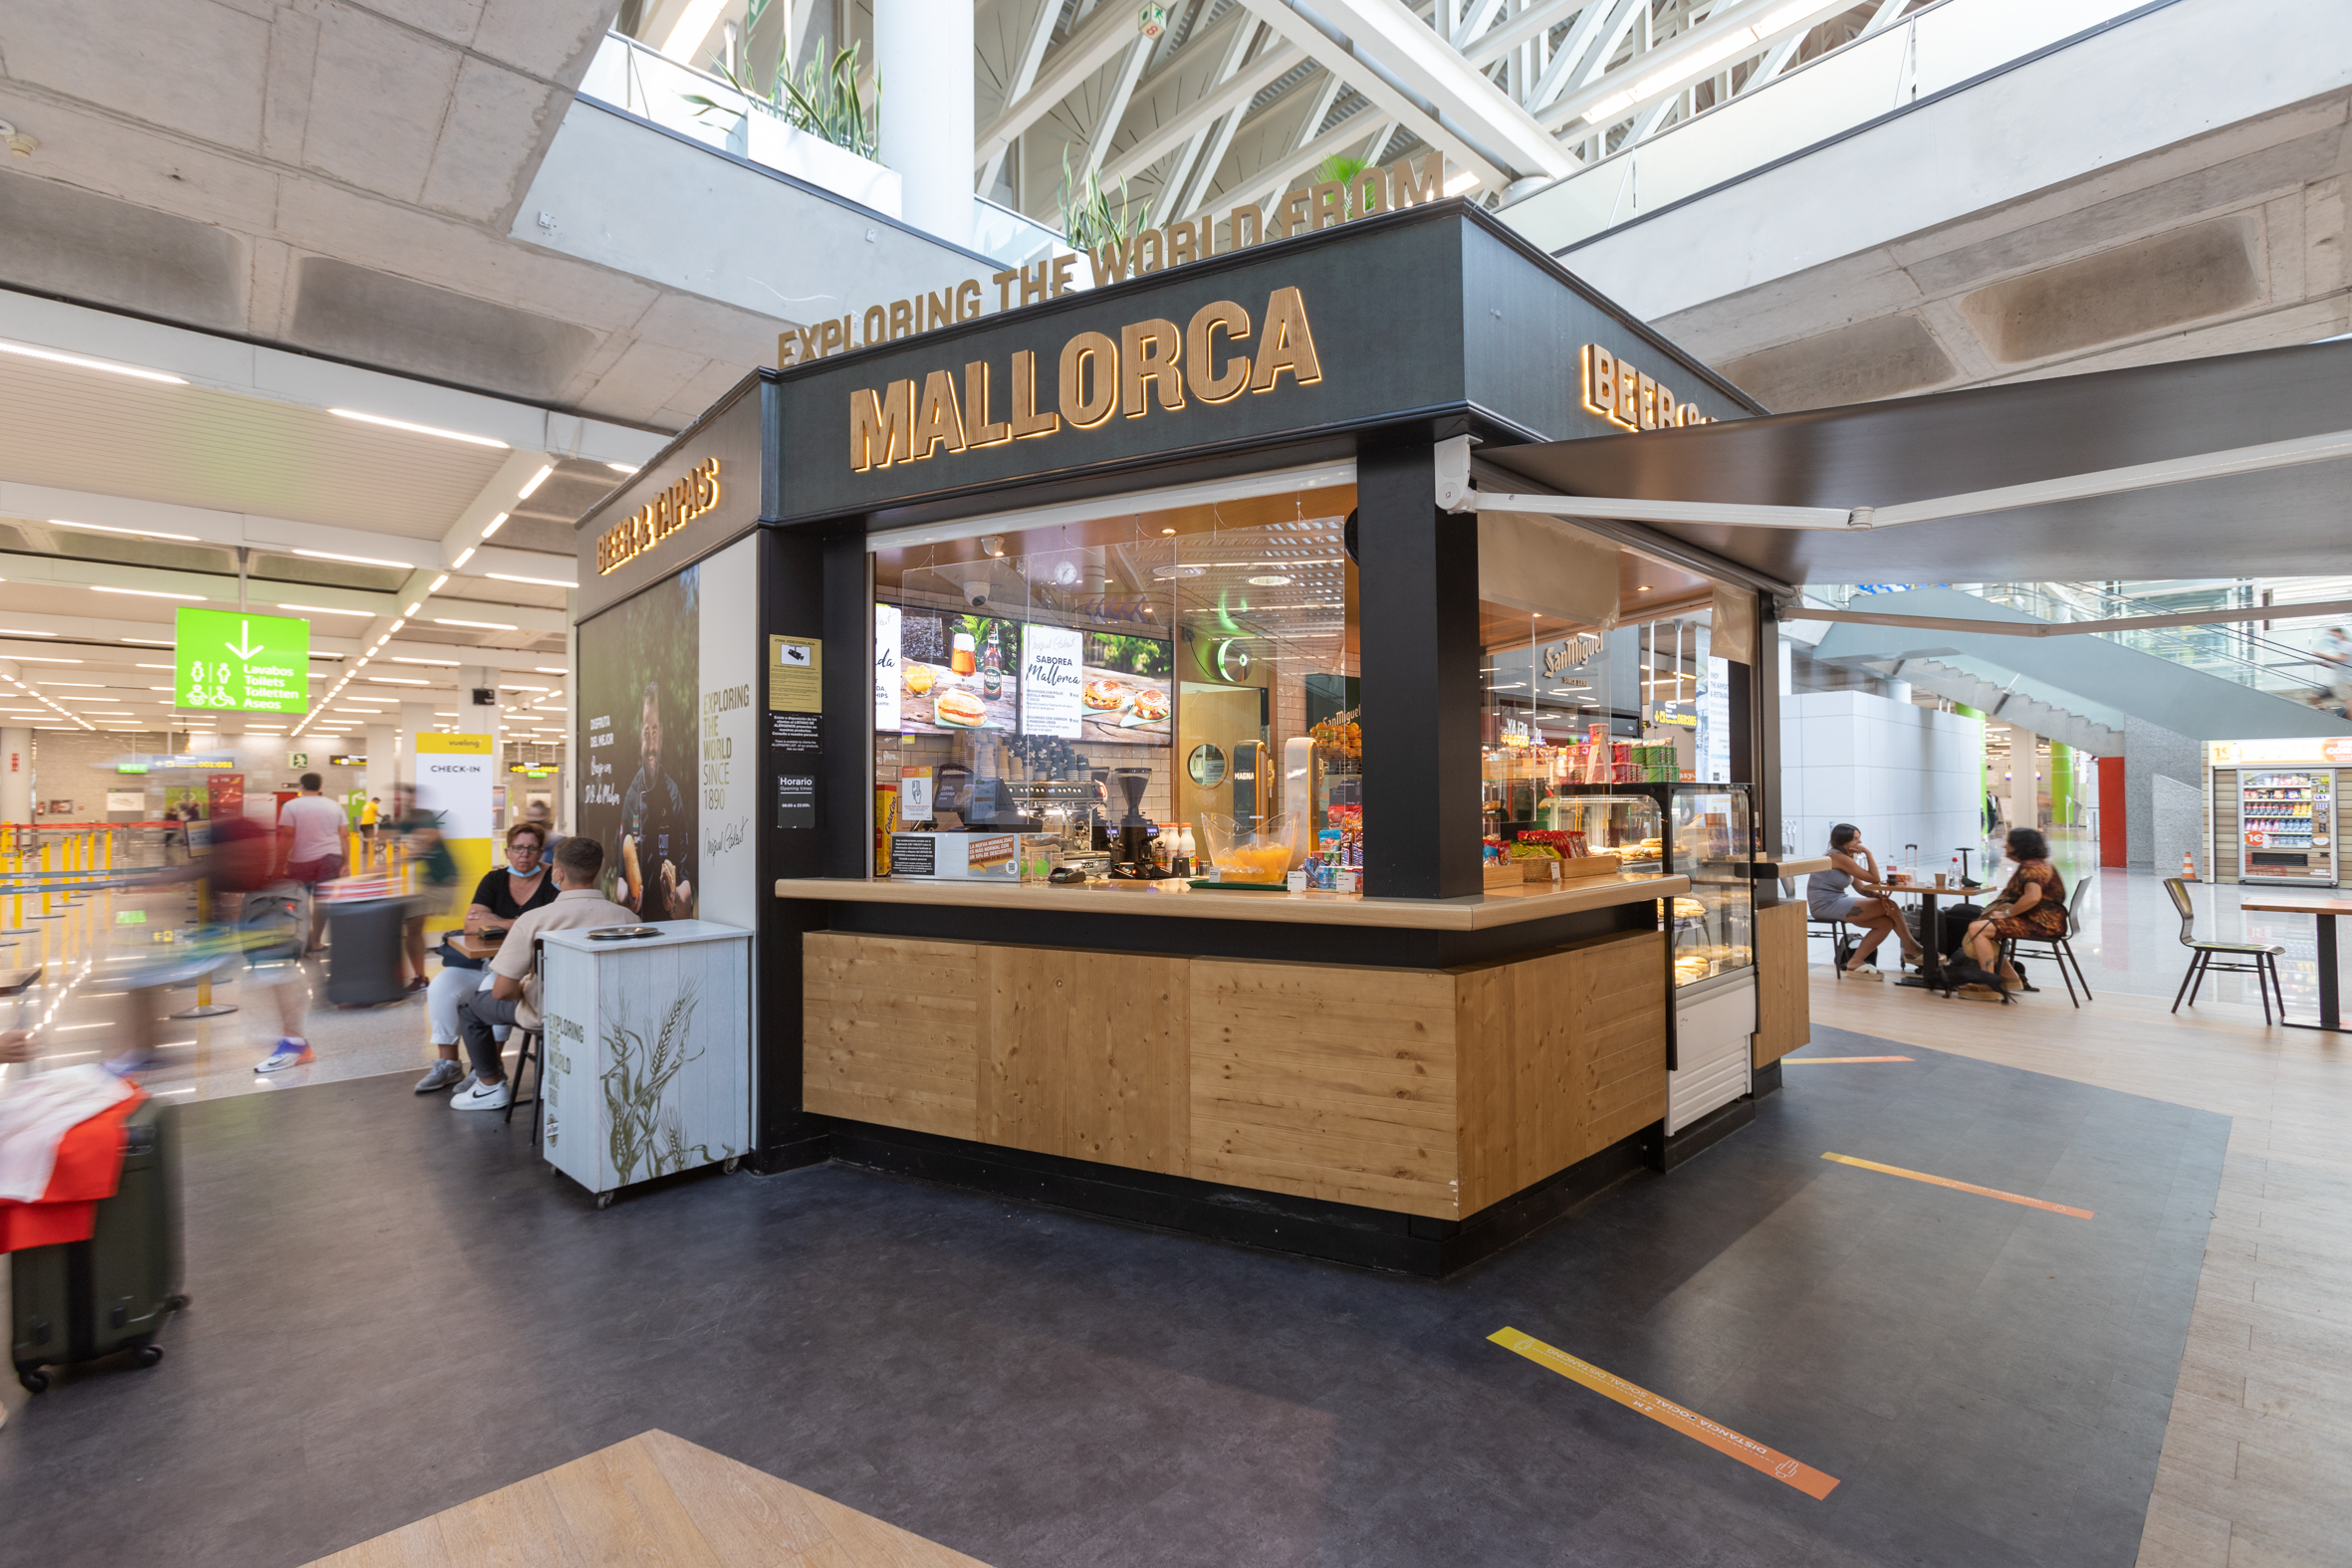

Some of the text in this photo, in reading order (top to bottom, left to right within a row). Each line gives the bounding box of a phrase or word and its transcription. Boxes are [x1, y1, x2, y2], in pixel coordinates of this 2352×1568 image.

[778, 150, 1446, 368] EXPLORING THE WORLD FROM
[850, 286, 1322, 473] MALLORCA
[1583, 342, 1677, 432] BEER
[596, 458, 719, 575] BEER & TAPAS
[875, 648, 896, 668] da
[1036, 655, 1073, 666] SABOREA
[243, 663, 295, 677] Lavabos
[244, 675, 286, 687] Toilets
[1025, 663, 1081, 687] Mallorca
[243, 698, 282, 710] Aseos
[244, 686, 299, 699] Toiletten
[703, 683, 750, 716] EXPLORING
[589, 715, 610, 731] DISFRUTA
[703, 715, 719, 739] THE
[703, 737, 732, 762] WORLD
[703, 762, 730, 786] SINCE
[1234, 772, 1255, 781] MAGNA
[704, 788, 725, 810] 1890
[988, 836, 1014, 846] NORMALIDAD
[549, 1011, 585, 1043] EXPLORING
[549, 1030, 561, 1051] THE
[549, 1048, 572, 1075] WORLD
[1546, 1348, 1767, 1455] DISTANCIA SOCIAL SOCIAL DISTANCING
[1633, 1400, 1644, 1409] M
